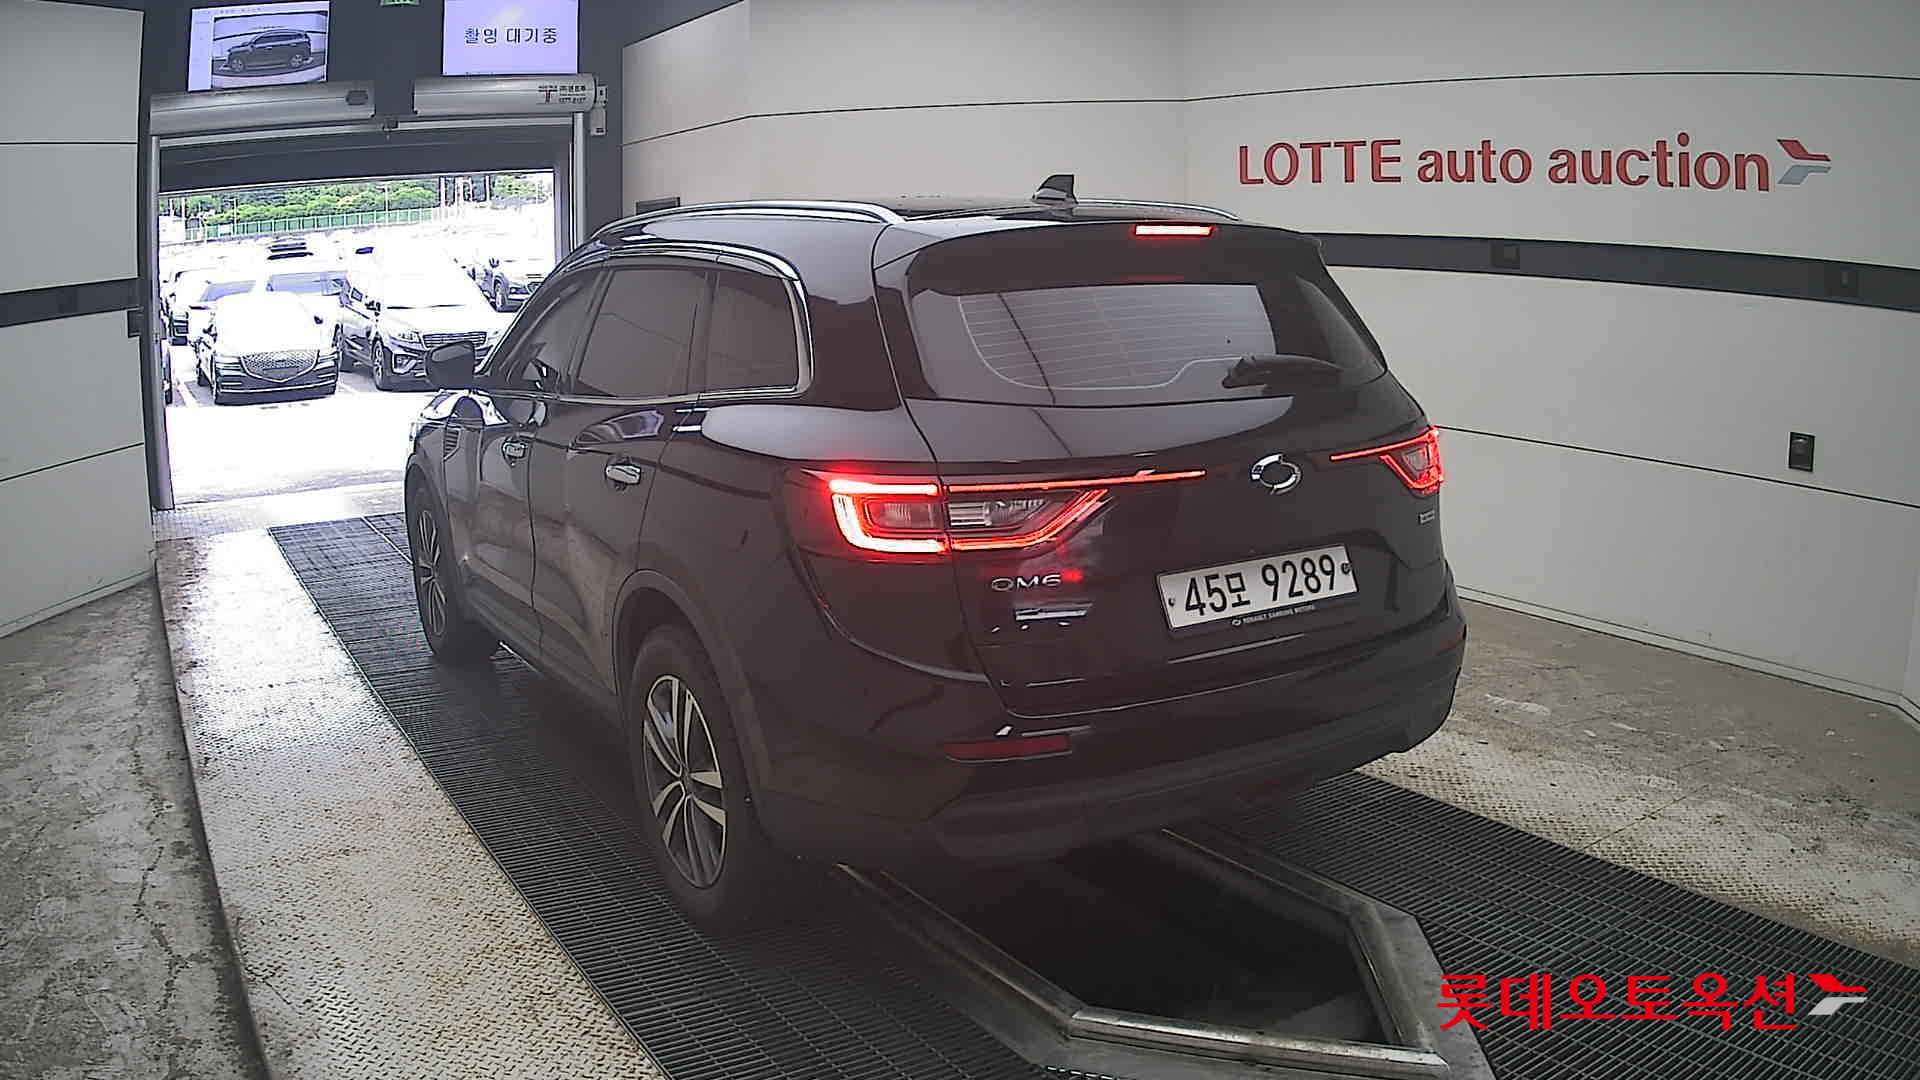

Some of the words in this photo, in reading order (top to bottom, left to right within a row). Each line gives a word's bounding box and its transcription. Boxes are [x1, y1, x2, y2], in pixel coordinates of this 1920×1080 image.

[506, 27, 558, 45] 대기중
[1240, 139, 1402, 185] LOTTE
[1418, 140, 1533, 184] auto
[1549, 132, 1770, 191] auction
[1184, 571, 1251, 616] 45모
[1261, 554, 1336, 602] 9289
